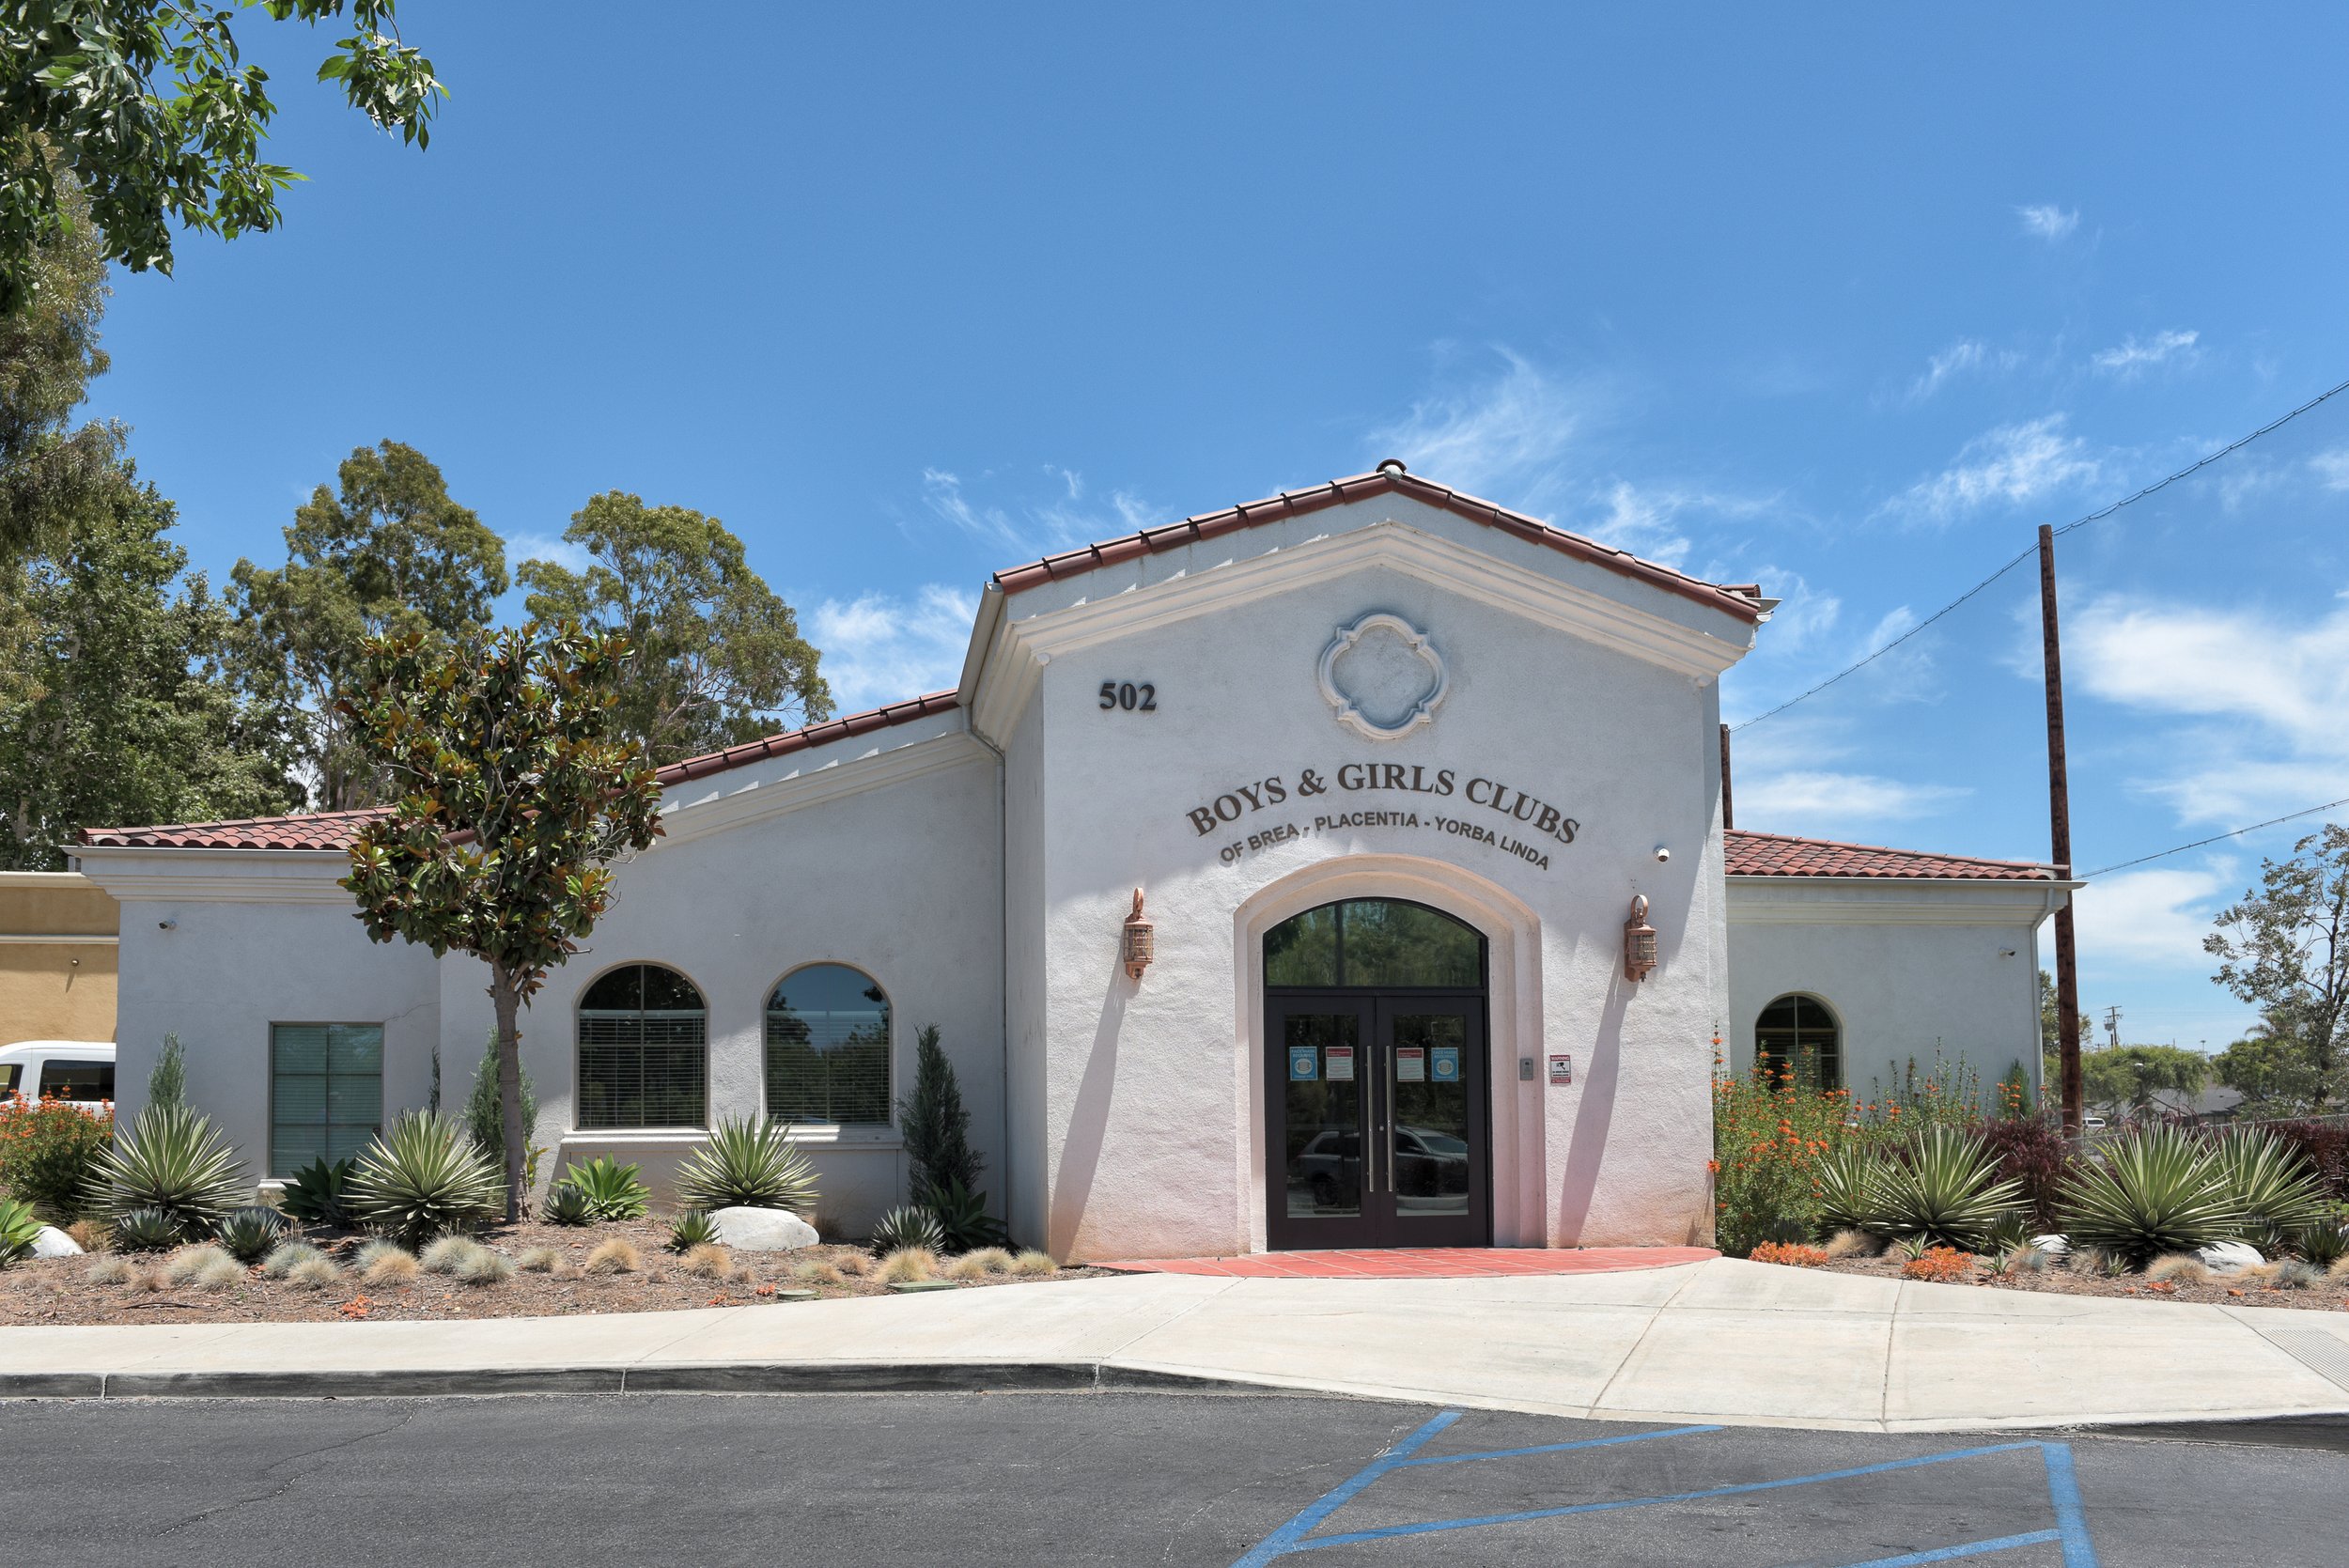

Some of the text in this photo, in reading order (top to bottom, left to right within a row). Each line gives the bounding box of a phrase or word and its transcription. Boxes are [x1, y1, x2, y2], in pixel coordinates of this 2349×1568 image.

[1099, 682, 1157, 711] 502
[1186, 764, 1581, 844] BOYS & GIRLS CLUBS
[1221, 842, 1244, 862] OF
[1248, 823, 1300, 851] BREA
[1315, 812, 1419, 831] PLACENTIA
[1435, 816, 1495, 846] YORBA
[1500, 836, 1549, 871] LINDA
